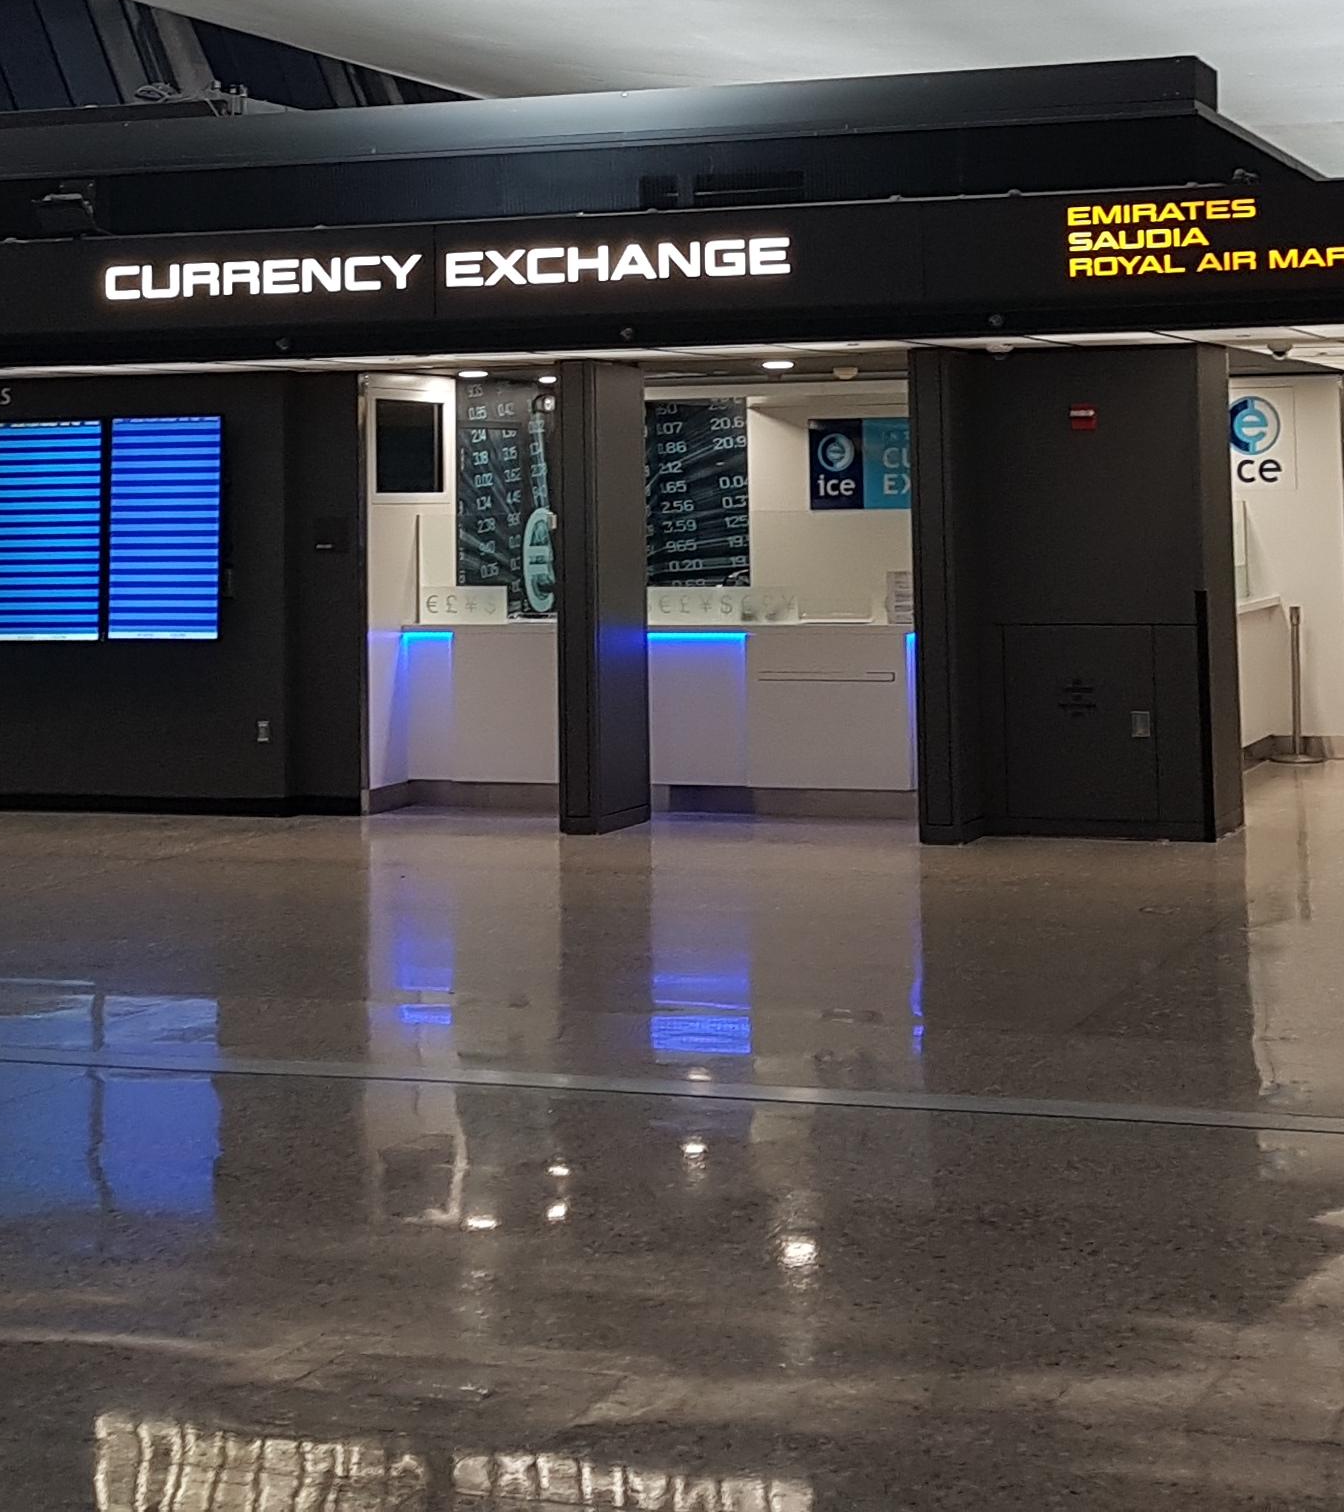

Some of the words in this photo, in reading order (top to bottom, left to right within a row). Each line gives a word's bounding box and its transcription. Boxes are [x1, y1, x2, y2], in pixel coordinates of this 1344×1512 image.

[1067, 198, 1256, 227] EMIRATES
[1068, 227, 1209, 252] SAUDIA
[104, 254, 423, 301] CURRENCY
[444, 237, 791, 288] EXCHANGE
[1069, 254, 1186, 278] ROYAL
[1197, 250, 1257, 272] AIR
[1237, 459, 1282, 483] ce
[817, 474, 856, 496] ice
